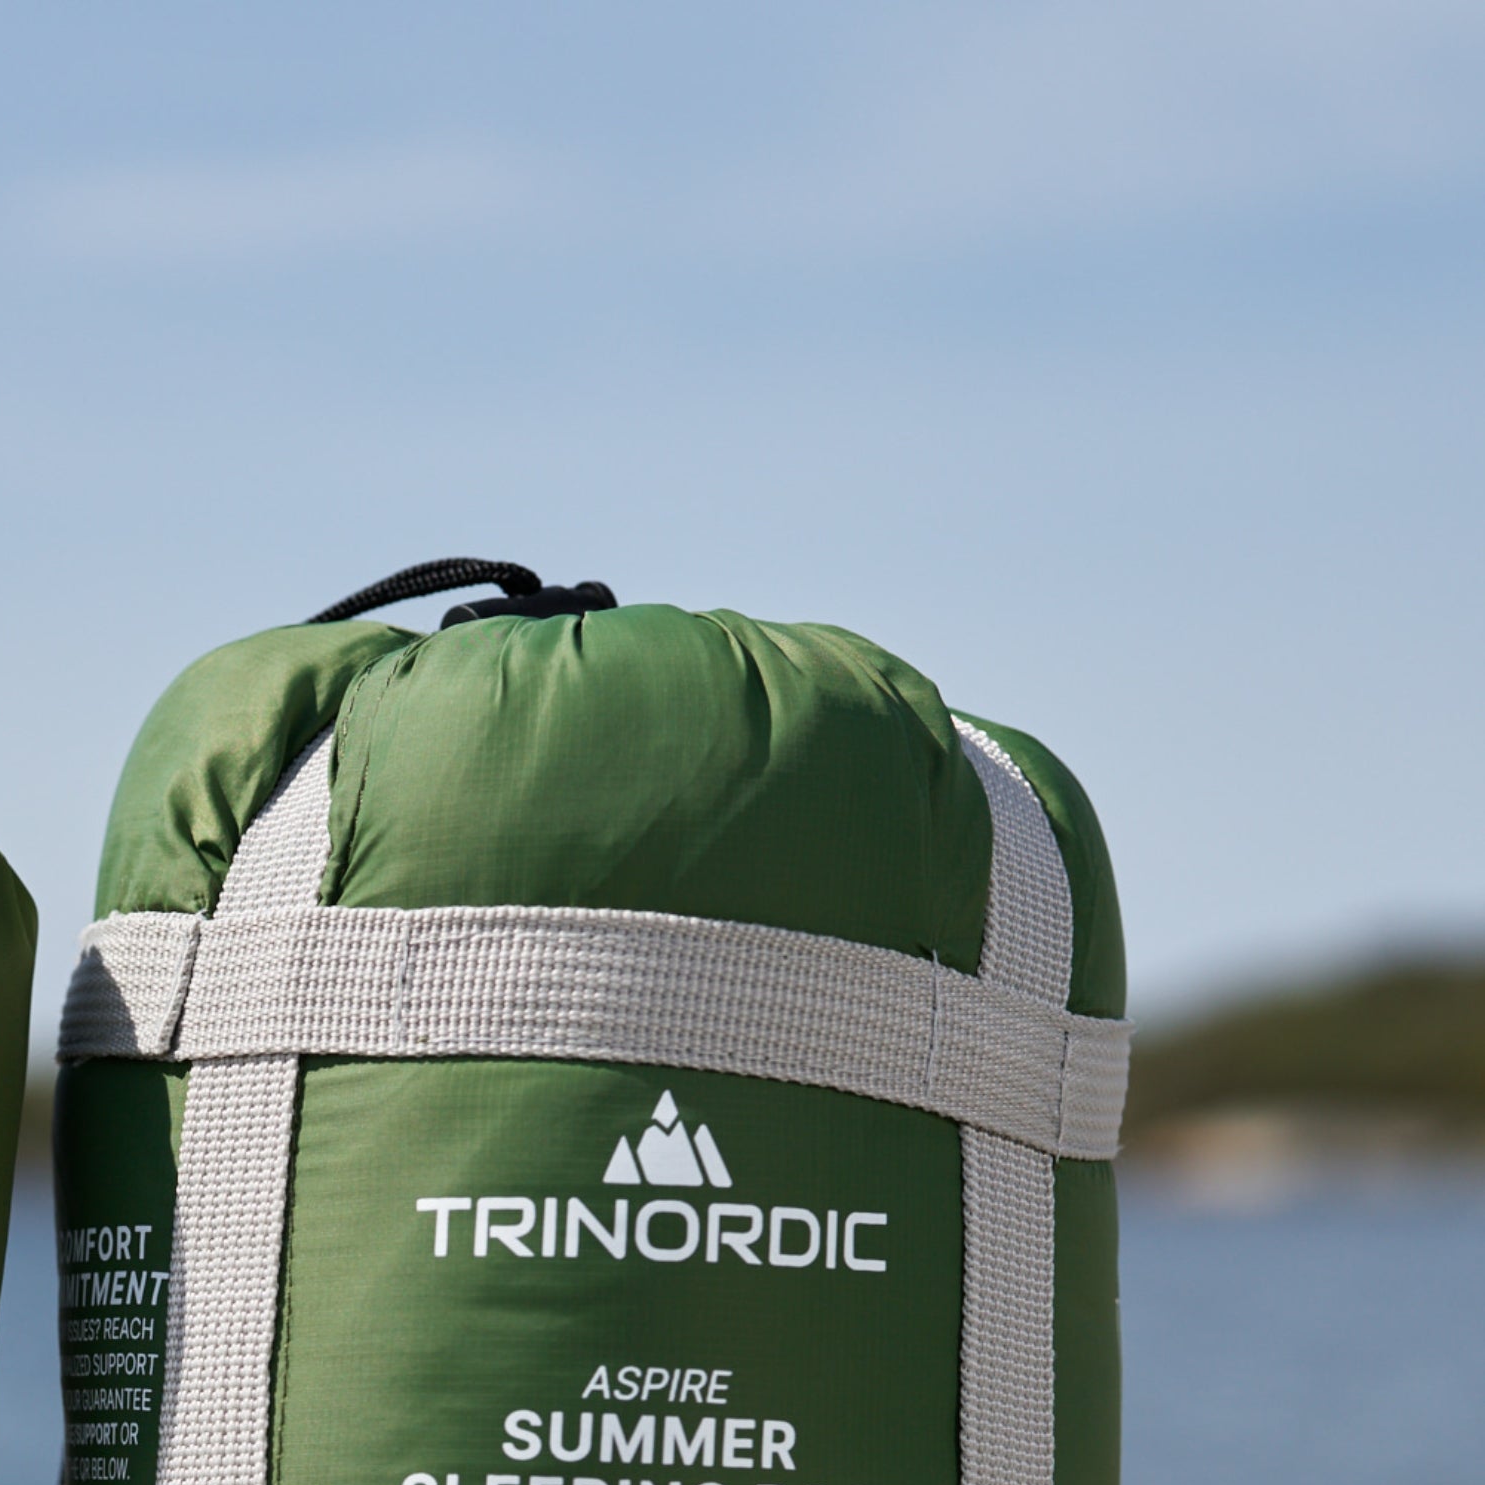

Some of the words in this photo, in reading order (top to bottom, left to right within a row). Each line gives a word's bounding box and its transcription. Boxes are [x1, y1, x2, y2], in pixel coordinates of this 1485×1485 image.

[416, 1197, 887, 1272] TRINORDIC
[103, 1317, 155, 1341] REACH
[93, 1353, 159, 1376] SUPPORT
[582, 1365, 732, 1405] ASPIRE
[82, 1387, 152, 1411] GUARANTEE
[120, 1422, 139, 1446] OR
[502, 1409, 796, 1470] SUMMER
[91, 1456, 130, 1480] BELOW.
